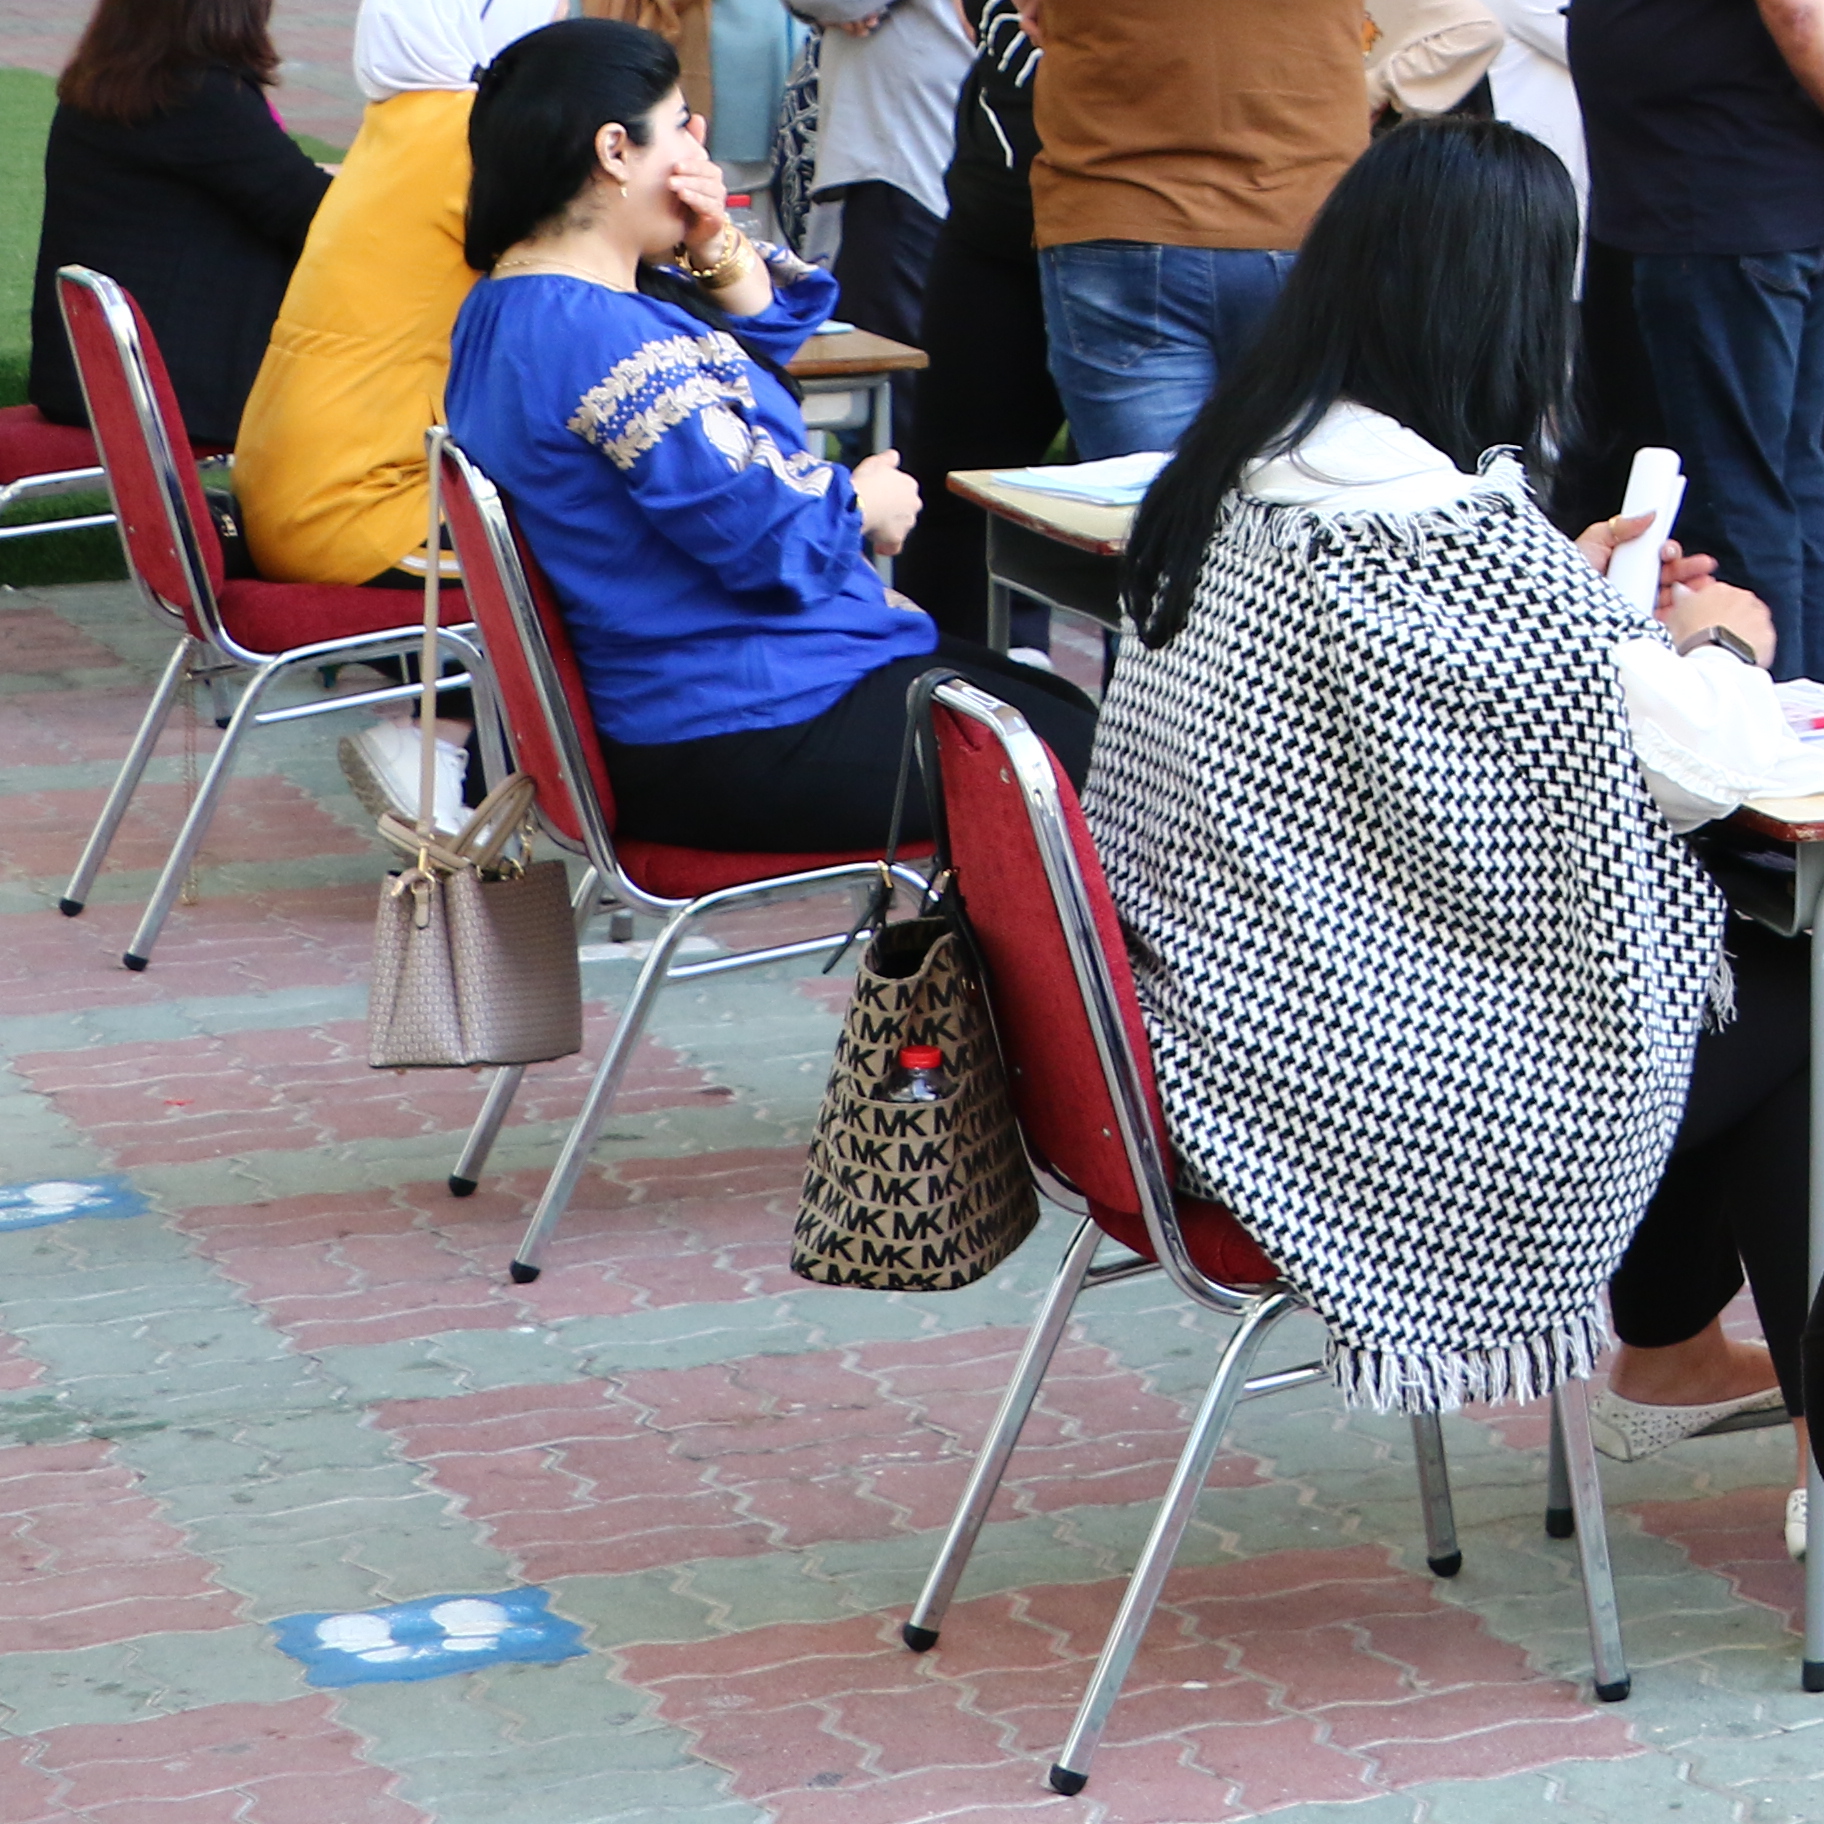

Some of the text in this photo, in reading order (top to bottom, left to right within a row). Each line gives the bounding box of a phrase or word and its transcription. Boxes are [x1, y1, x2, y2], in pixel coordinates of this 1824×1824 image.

[860, 1012, 906, 1044] MK
[874, 1107, 926, 1137] MK
[851, 1134, 950, 1172] MK MK
[871, 1174, 921, 1206] MK
[928, 1164, 964, 1204] MK
[846, 1203, 887, 1238] MK
[893, 1206, 944, 1240] MK
[813, 1226, 855, 1263] MK
[862, 1239, 915, 1270] MK
[921, 1231, 968, 1270] MK
